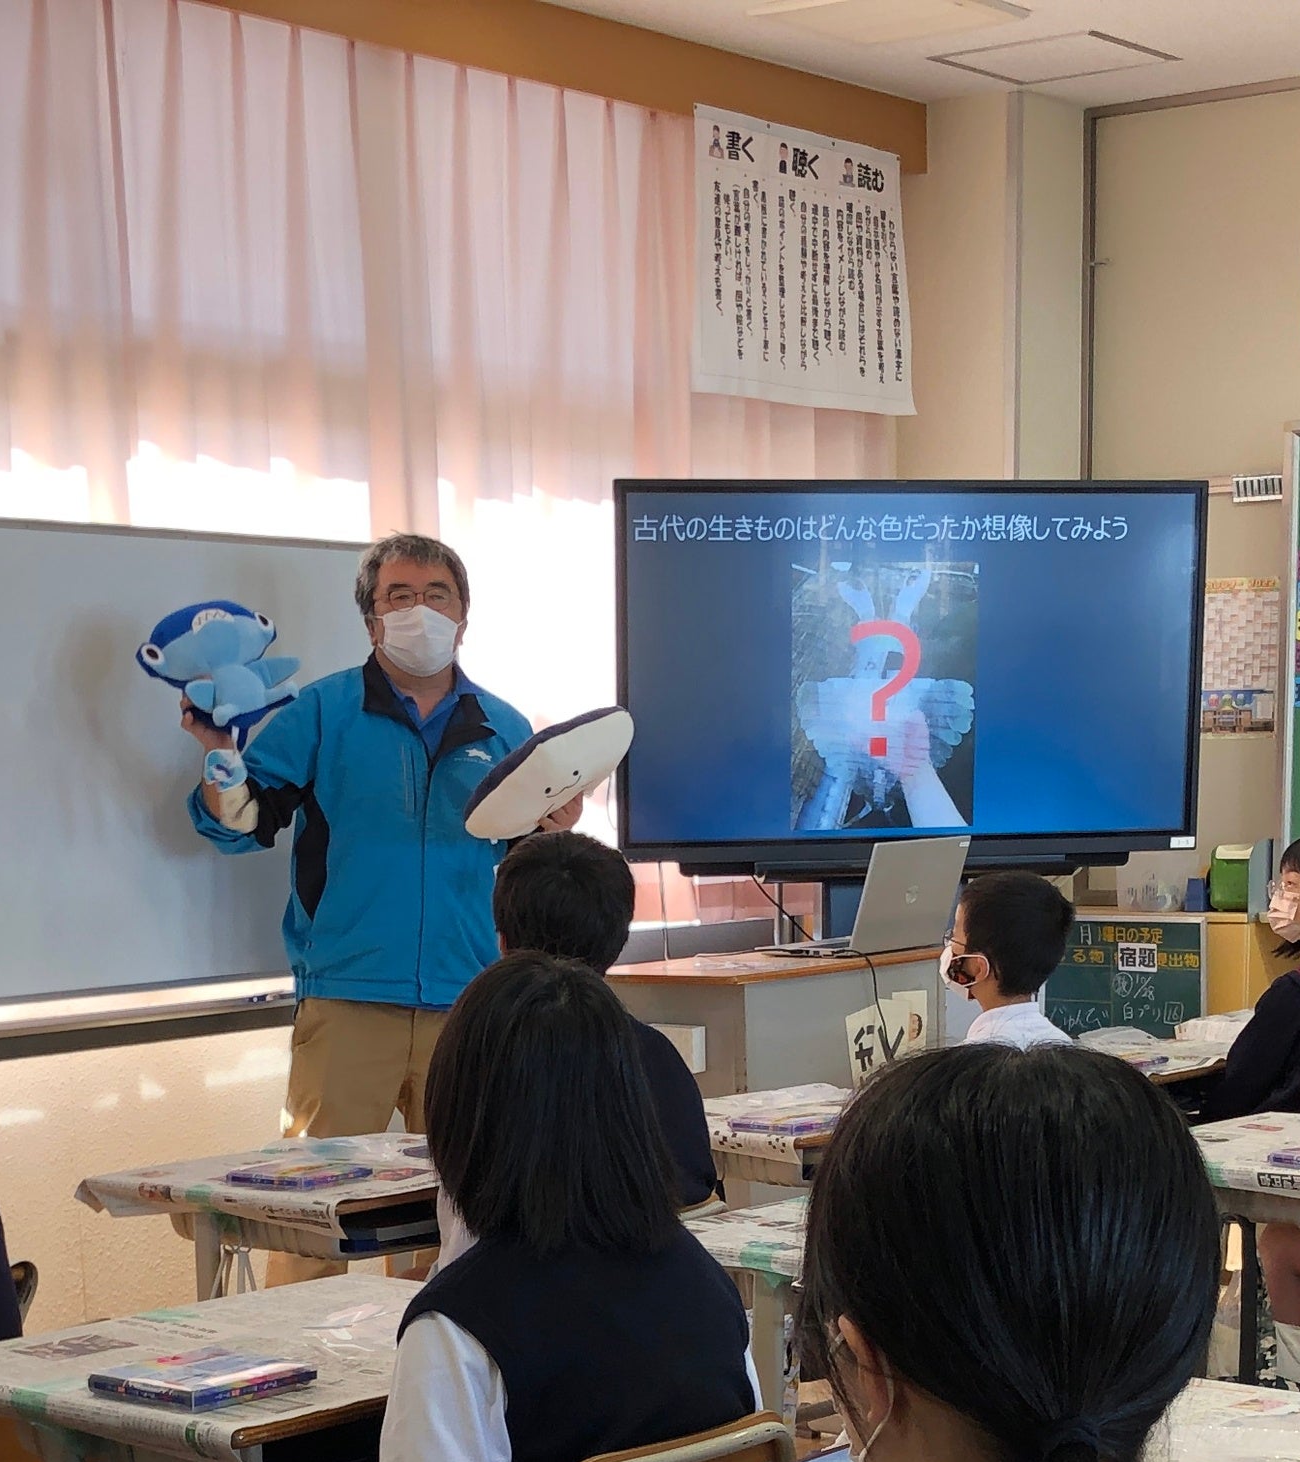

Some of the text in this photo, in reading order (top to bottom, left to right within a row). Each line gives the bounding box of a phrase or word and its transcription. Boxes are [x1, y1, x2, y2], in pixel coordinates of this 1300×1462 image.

[725, 130, 755, 163] 書く
[791, 147, 820, 180] 聴く
[857, 162, 885, 193] 読む
[632, 513, 1129, 545] 古代の生きものはどんな色だったか想像してみよう
[1119, 946, 1157, 969] 宿題
